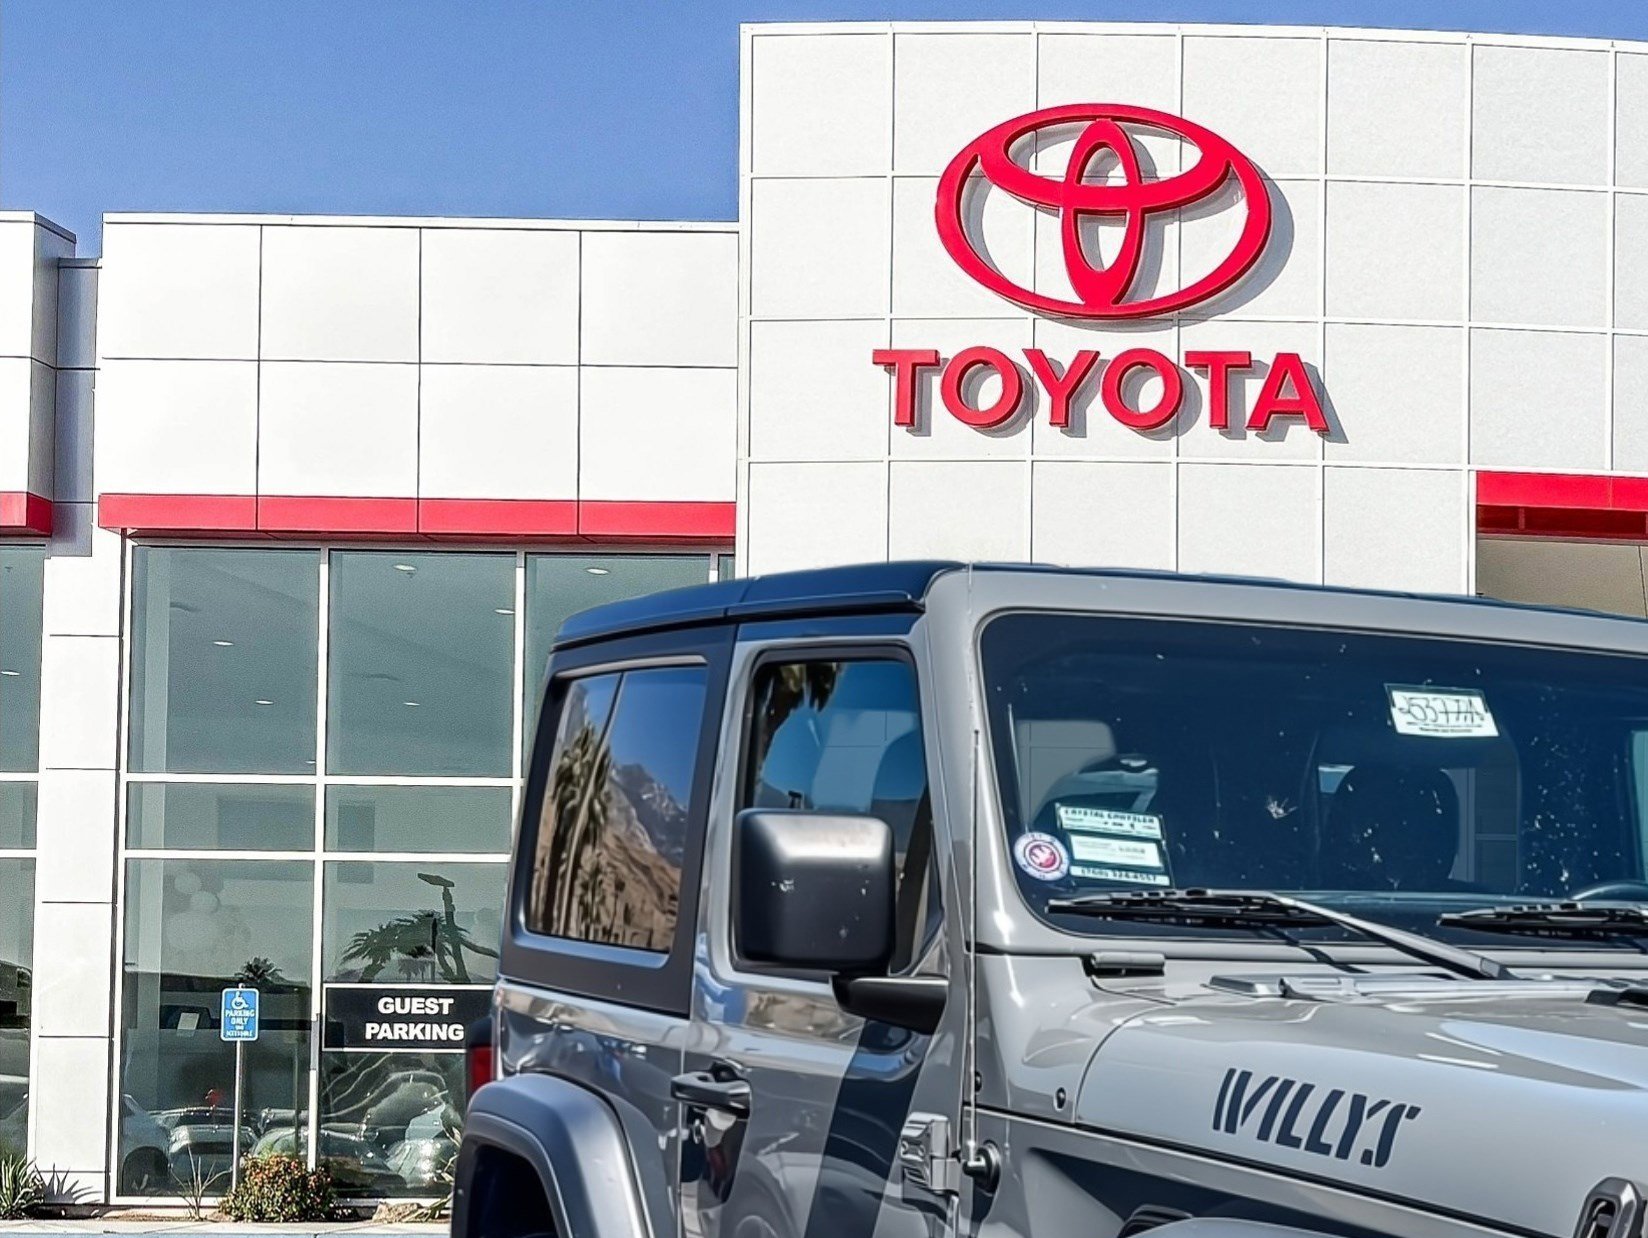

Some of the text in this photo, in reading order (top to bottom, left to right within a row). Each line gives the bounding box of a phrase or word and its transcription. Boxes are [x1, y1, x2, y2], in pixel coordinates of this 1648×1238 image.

[873, 346, 1330, 432] TOYOTA
[365, 1022, 465, 1041] PARKING
[378, 997, 454, 1015] GUEST
[1212, 1067, 1422, 1168] WILLYS
